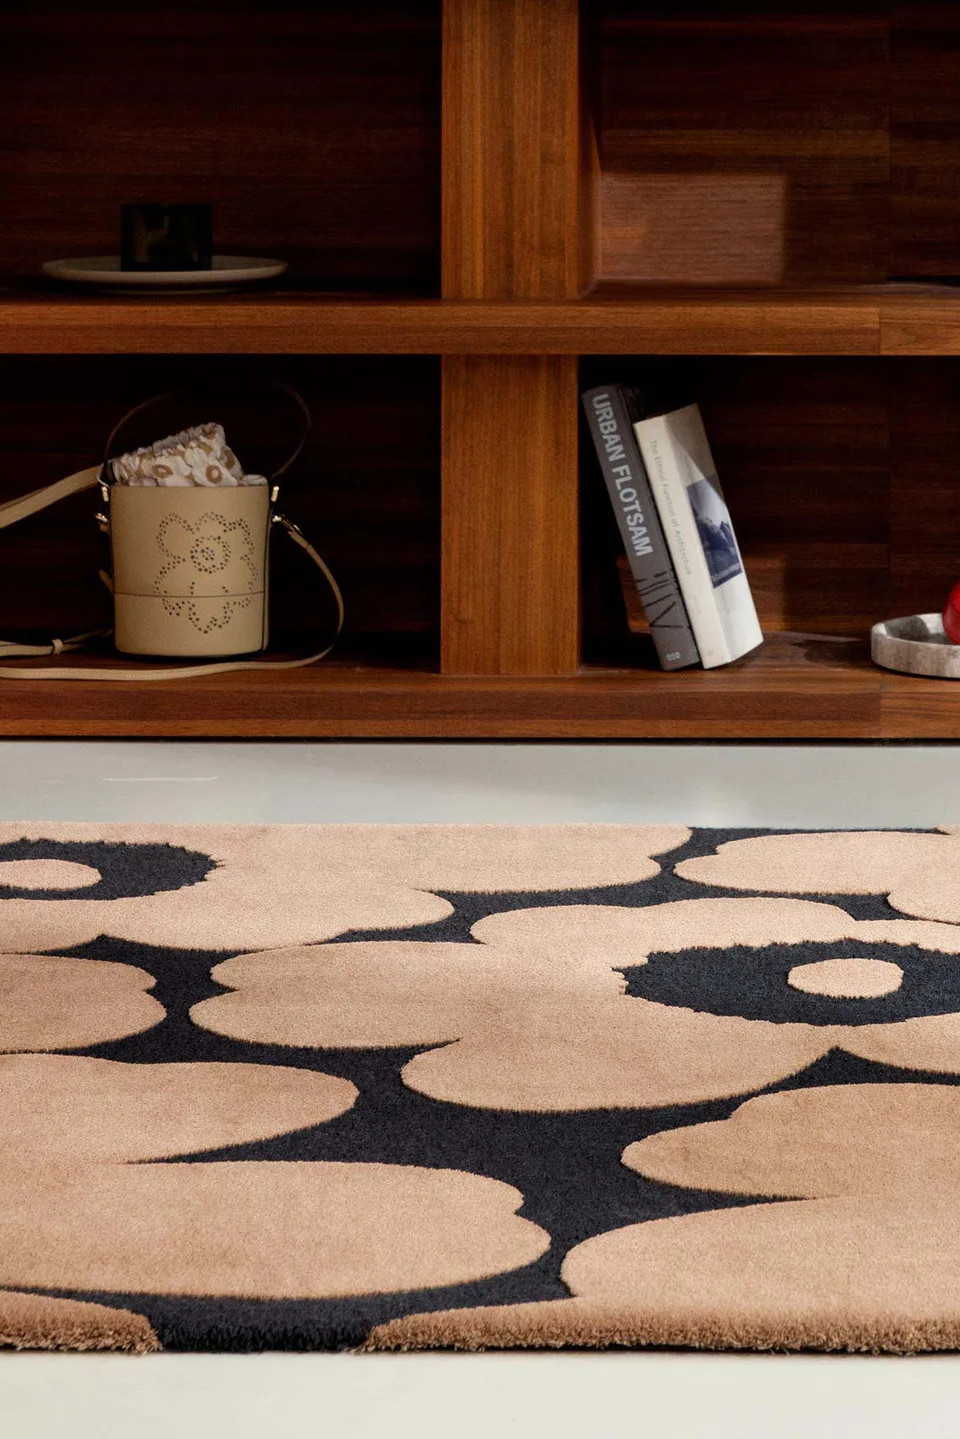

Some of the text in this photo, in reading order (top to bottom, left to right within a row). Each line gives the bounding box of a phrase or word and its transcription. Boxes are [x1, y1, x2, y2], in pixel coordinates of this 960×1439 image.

[592, 393, 654, 557] URBAN FLOTSAM
[650, 440, 658, 453] The
[654, 456, 667, 482] Ethical
[663, 483, 676, 517] Function
[675, 529, 691, 576] Architecture
